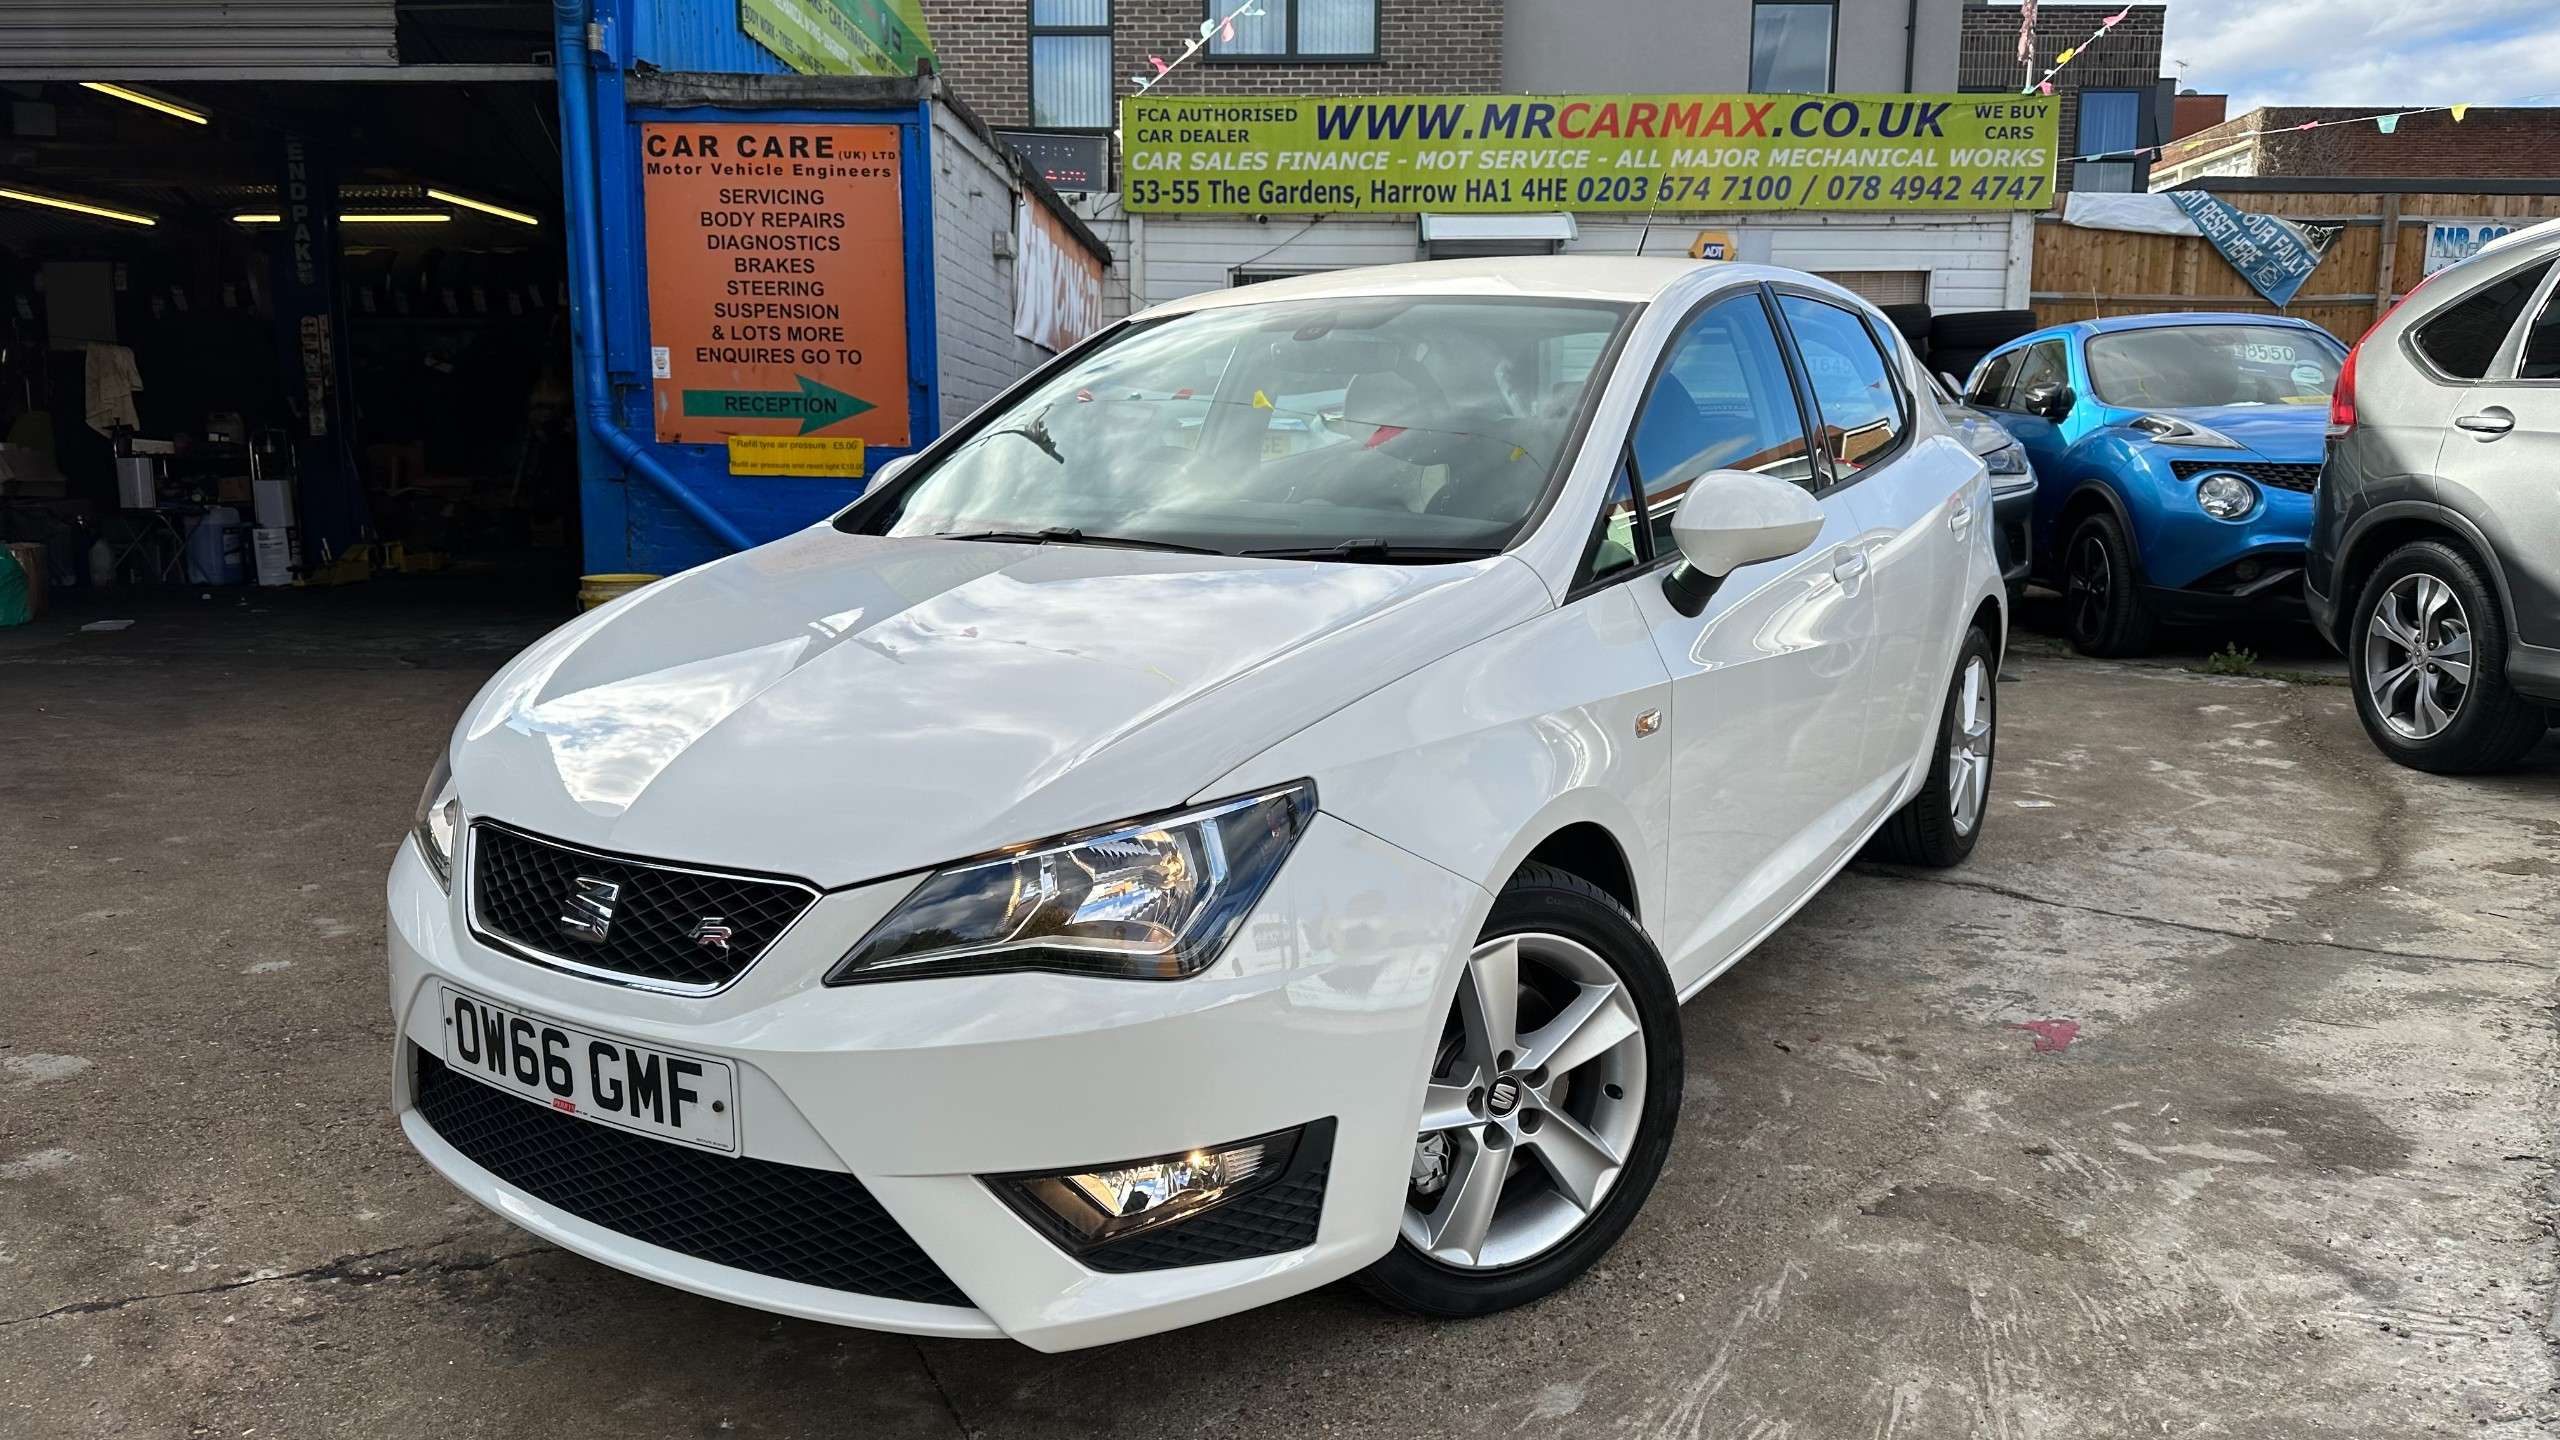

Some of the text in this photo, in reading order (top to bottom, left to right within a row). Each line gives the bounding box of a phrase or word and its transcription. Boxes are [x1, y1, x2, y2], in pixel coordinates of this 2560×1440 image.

[1137, 108, 1297, 122] FCA AUTHORISED
[1317, 102, 1952, 140] WWW.MRCARMAX.CO.UK
[1975, 105, 2048, 119] WE BUY
[1137, 128, 1250, 143] CAR DEALER
[1985, 125, 2034, 140] CARS
[647, 134, 896, 161] CAR CARE (UK) LTD
[1132, 151, 1186, 171] CAR
[1190, 151, 1269, 170] SALES
[1276, 151, 1390, 170] FINANCE
[1415, 150, 1473, 170] MOT
[1479, 149, 1590, 169] SERVICE
[1615, 148, 1662, 168] ALL
[1671, 148, 1760, 168] MAJOR
[1767, 147, 1939, 168] MECHANICAL
[1950, 147, 2046, 168] WORKS
[647, 163, 891, 179] Motor Vehicle Engineers
[719, 188, 825, 205] SERVICING
[1132, 180, 1200, 204] 53-55
[1207, 179, 1251, 204] The
[1259, 179, 1361, 209] Gardens,
[1370, 178, 1456, 203] Harrow
[1465, 178, 1512, 202] HA1
[1521, 178, 1567, 201] 4HE
[1577, 176, 1649, 201] 0203
[1659, 175, 1711, 201] 674
[1722, 175, 1792, 201] 7100
[1827, 175, 1882, 201] 078
[1889, 175, 1962, 201] 4942
[1971, 174, 2045, 201] 4747
[700, 211, 846, 229] BODY REPAIRS
[2237, 210, 2278, 245] OUR
[707, 234, 841, 252] DIAGNOSTICS
[2195, 201, 2239, 242] RESET
[2223, 231, 2264, 269] HERE
[1703, 245, 1725, 258] ADT
[734, 258, 815, 274] BRAKES
[727, 280, 825, 297] STEERING
[714, 302, 840, 320] SUSPENSION
[711, 325, 845, 343] & LOTS MORE
[696, 348, 862, 366] ENQUIRES GO TO
[724, 396, 837, 414] RECEPTION
[455, 997, 703, 1129] OW66 GMF
